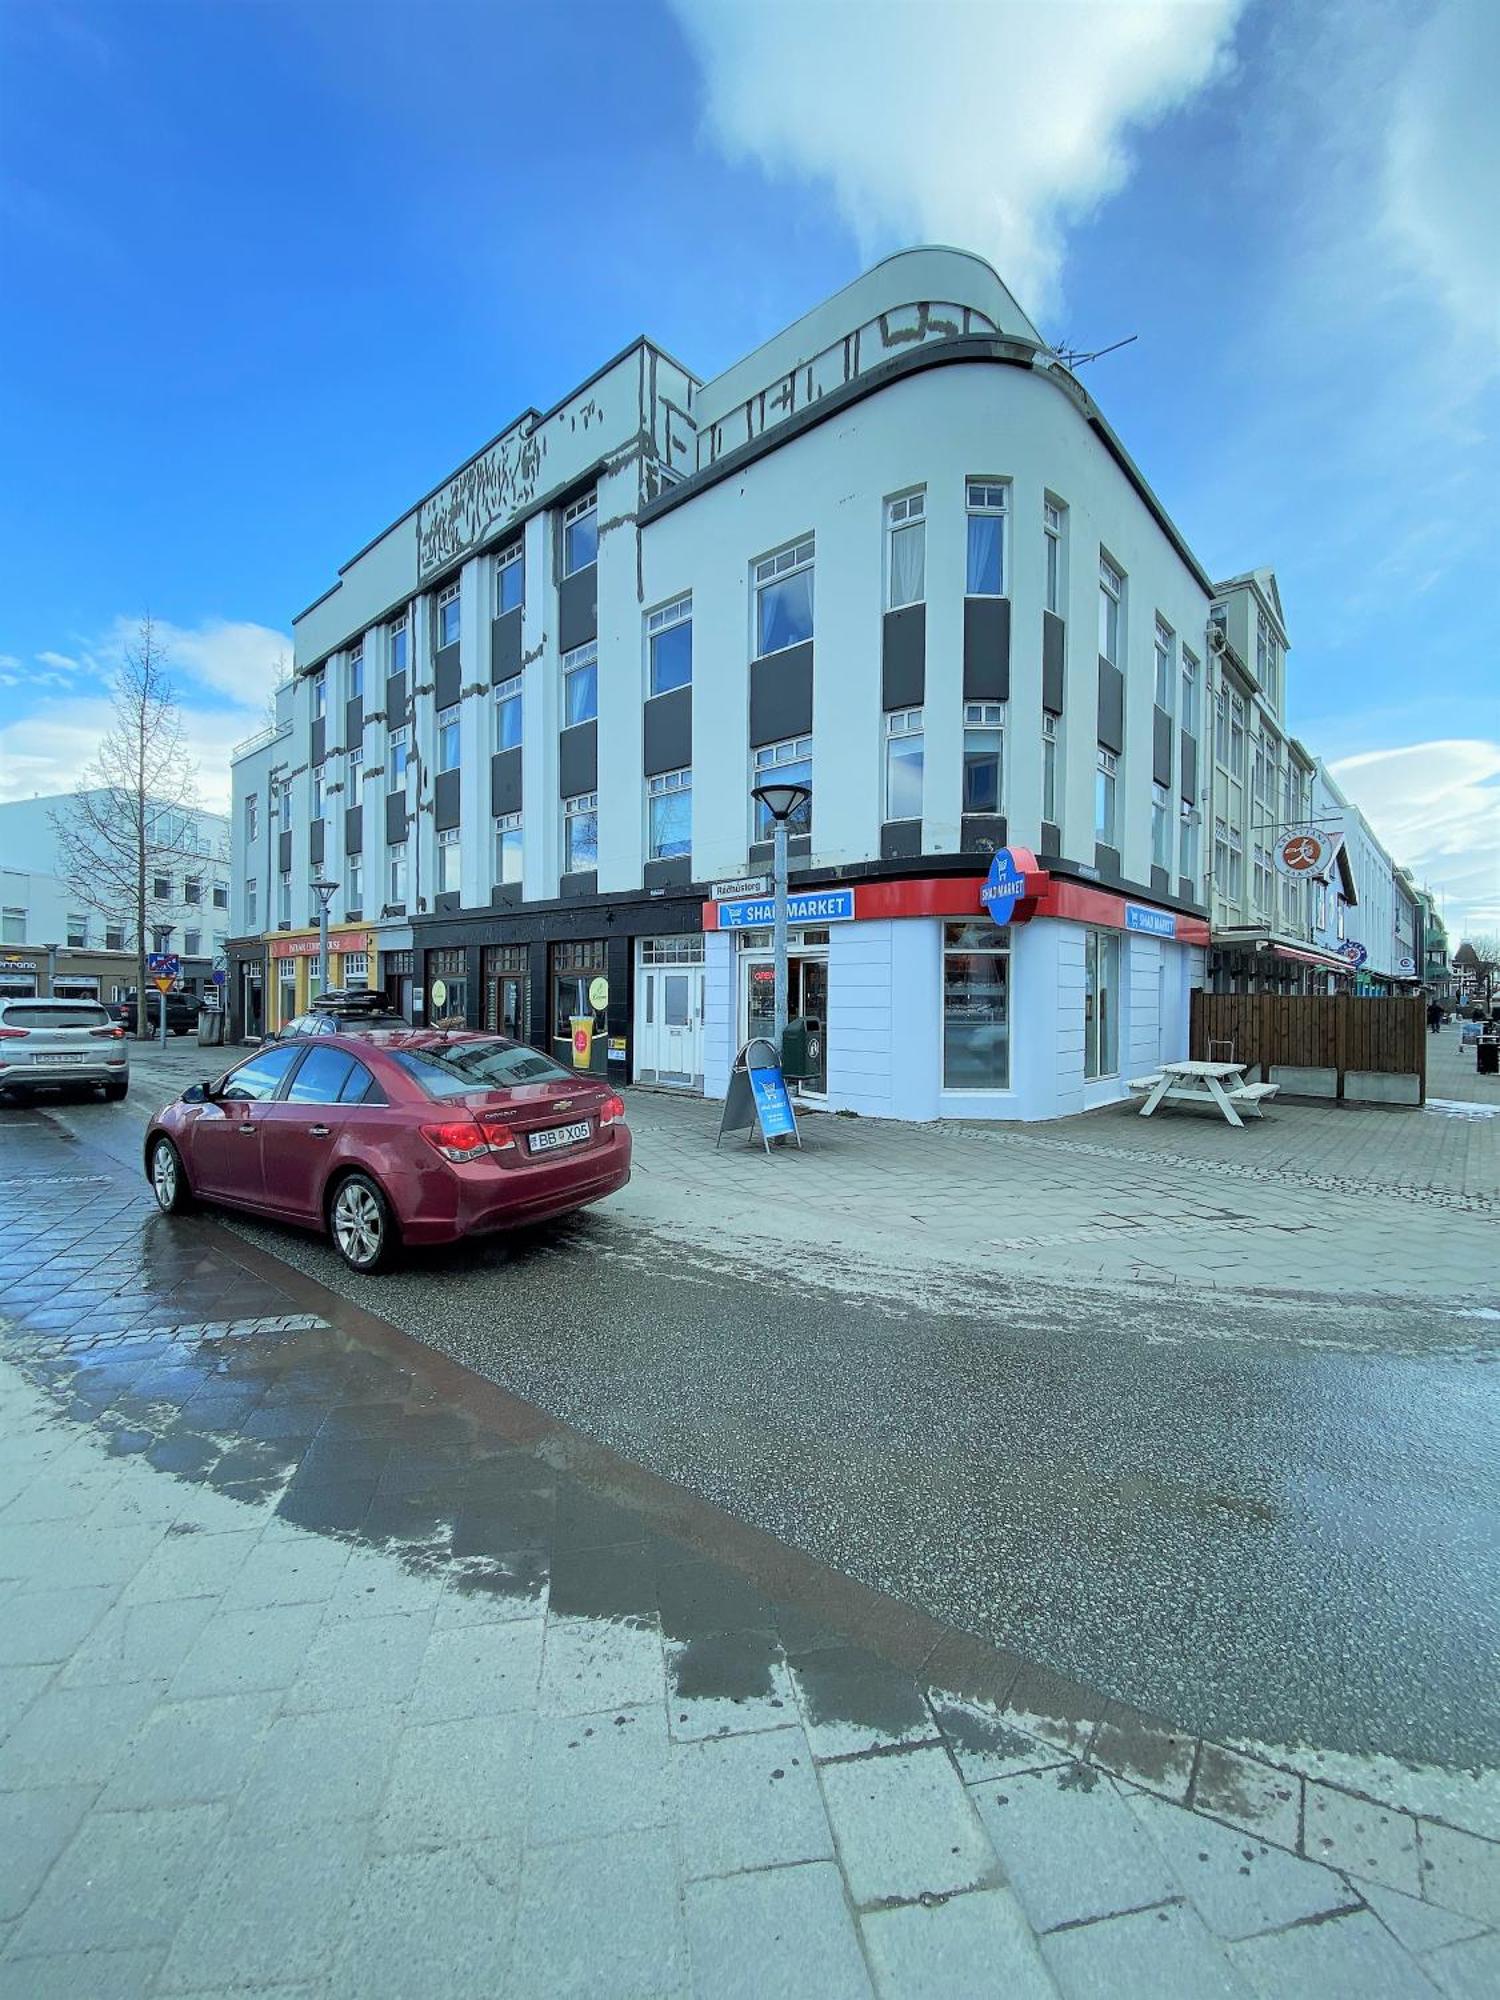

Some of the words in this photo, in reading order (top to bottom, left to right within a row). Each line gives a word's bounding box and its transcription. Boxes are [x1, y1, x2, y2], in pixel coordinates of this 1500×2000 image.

[747, 904, 776, 921] SHA
[786, 898, 845, 918] MARKET
[539, 1131, 557, 1148] BB
[566, 1124, 589, 1141] X05
